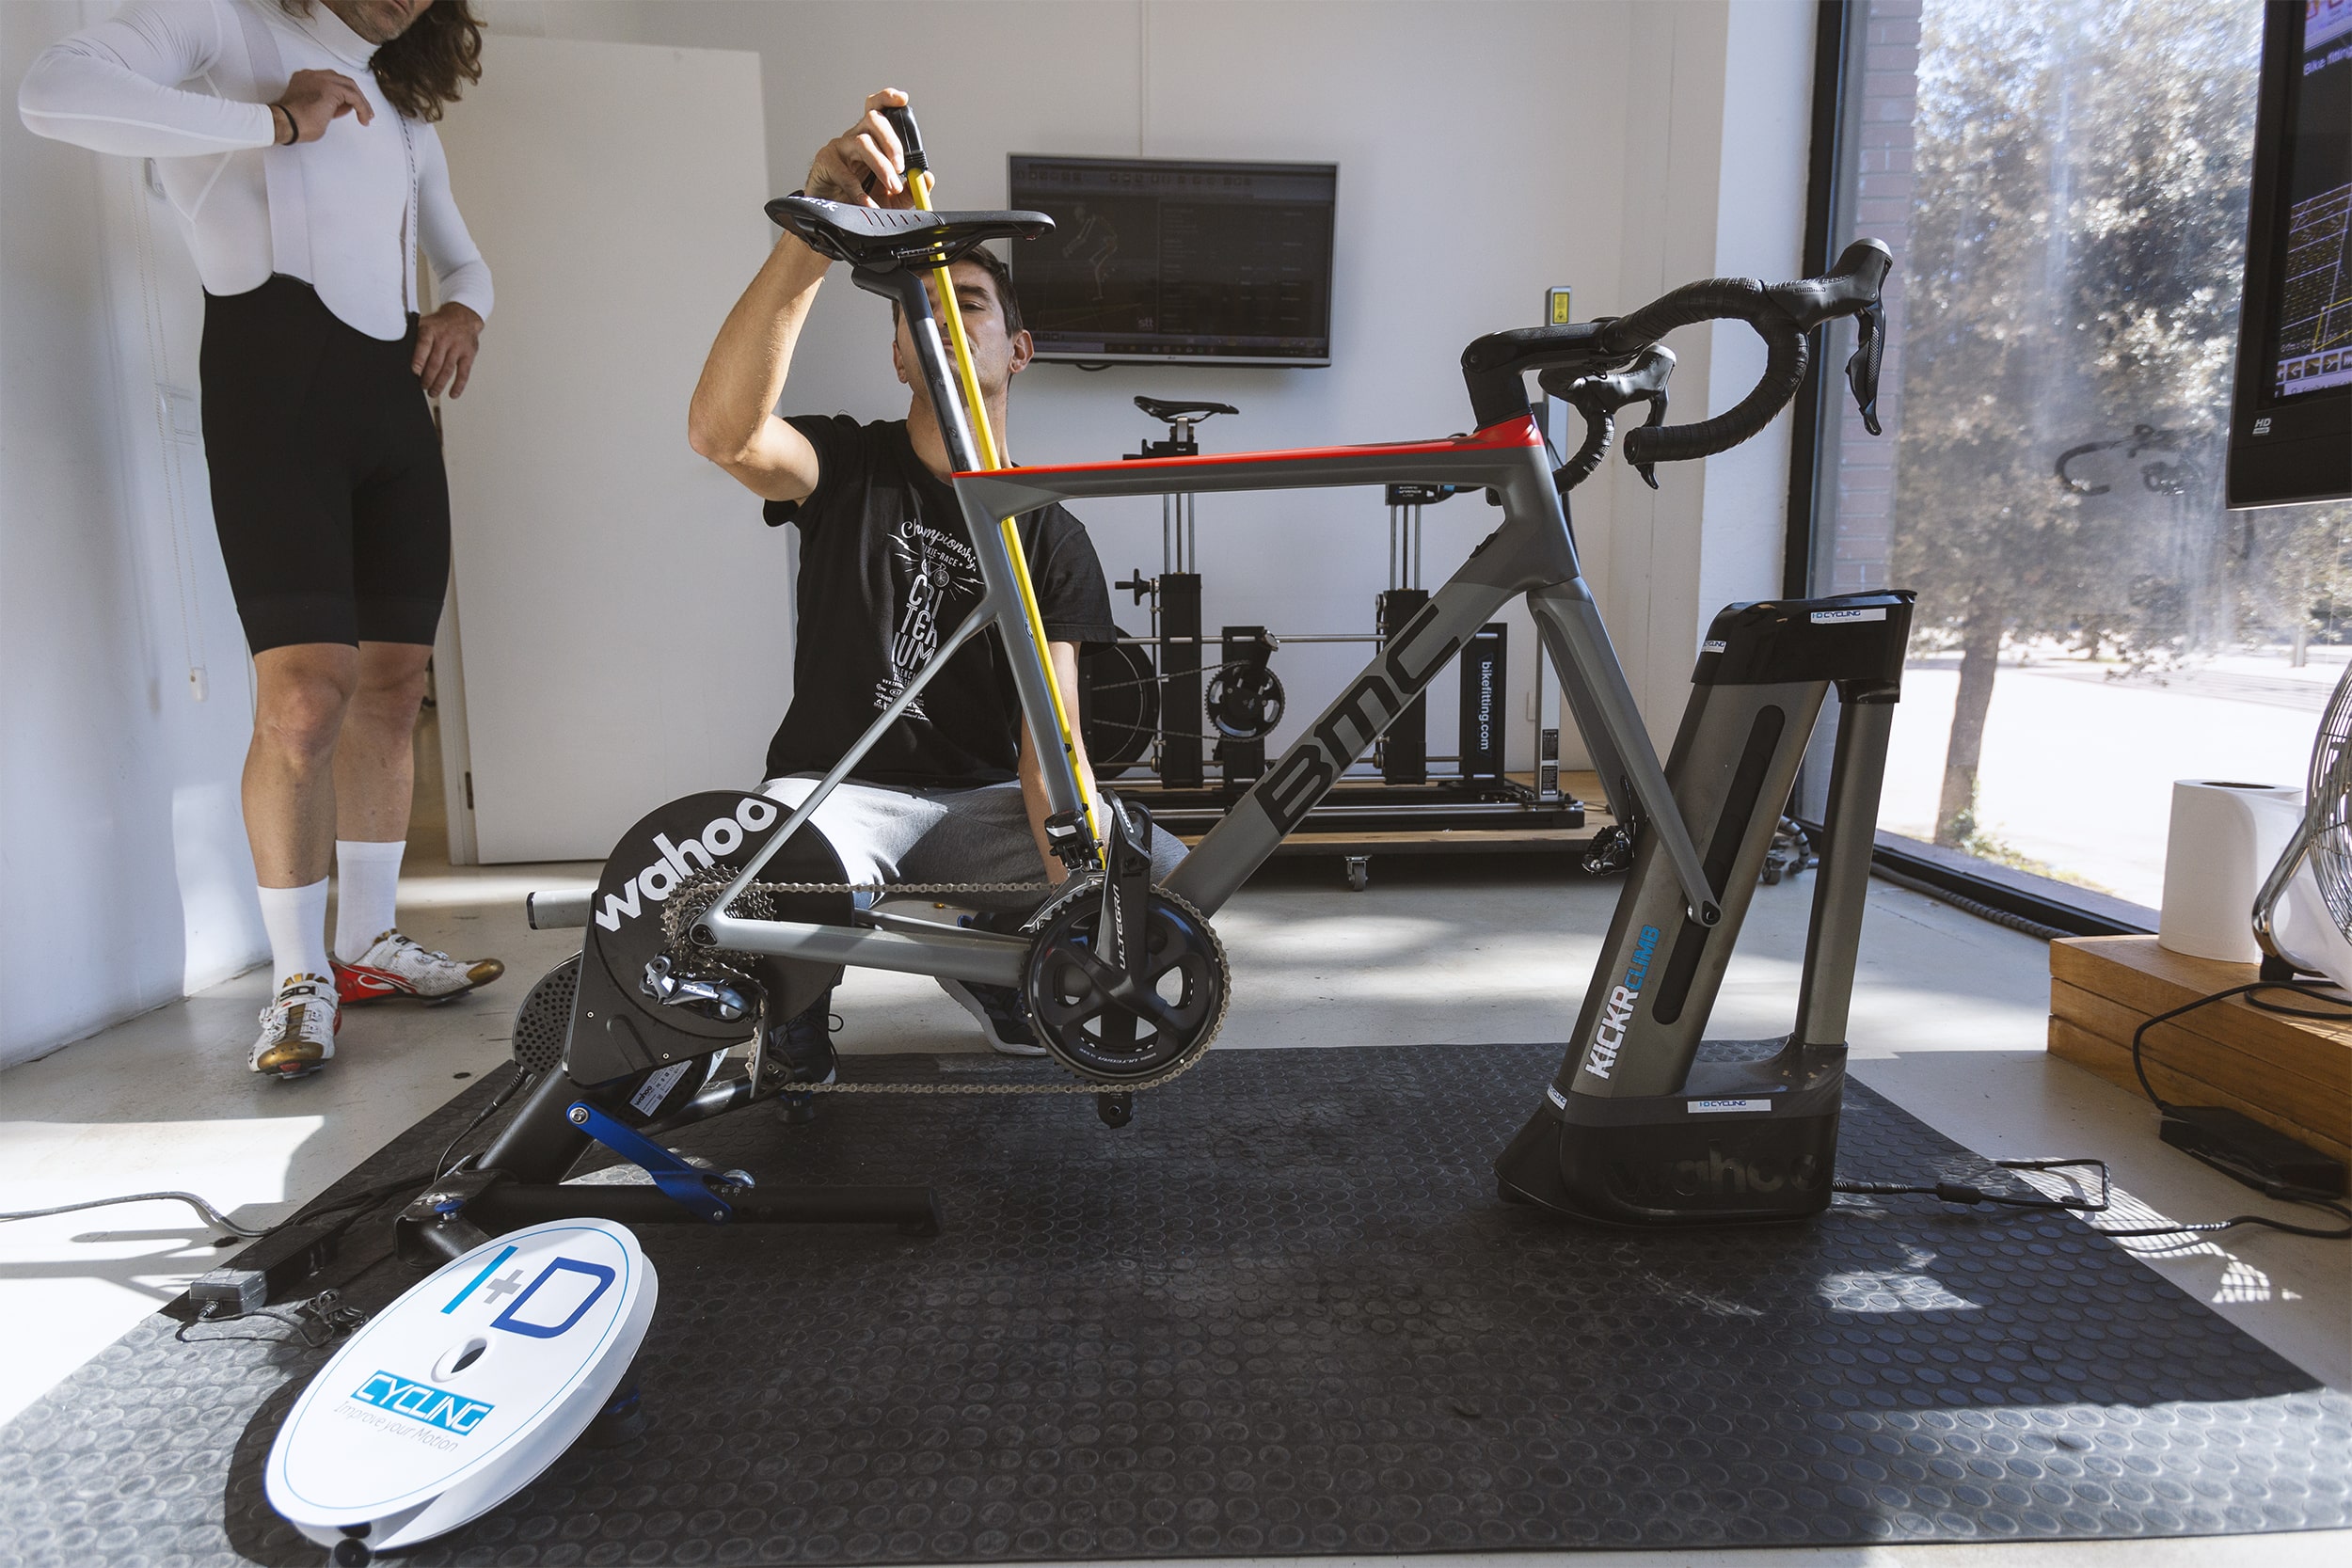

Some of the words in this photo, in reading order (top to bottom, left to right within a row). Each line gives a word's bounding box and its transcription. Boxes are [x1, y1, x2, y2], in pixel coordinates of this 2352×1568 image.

[2254, 418, 2272, 428] HD
[922, 543, 959, 567] IXIE-RACE
[1823, 610, 1861, 618] CYCLING
[1254, 603, 1461, 836] BMC
[1478, 661, 1493, 751] bikefitting.com
[595, 797, 778, 933] wahoo
[1112, 883, 1127, 971] ULTEGRA
[1584, 985, 1639, 1080] KICKR
[1624, 925, 1660, 990] CLIMB
[634, 1085, 653, 1106] wahoo
[333, 1401, 387, 1431] Improve
[380, 1418, 418, 1440] your
[411, 1426, 459, 1453] Motion
[356, 1373, 491, 1432] CYCLING
